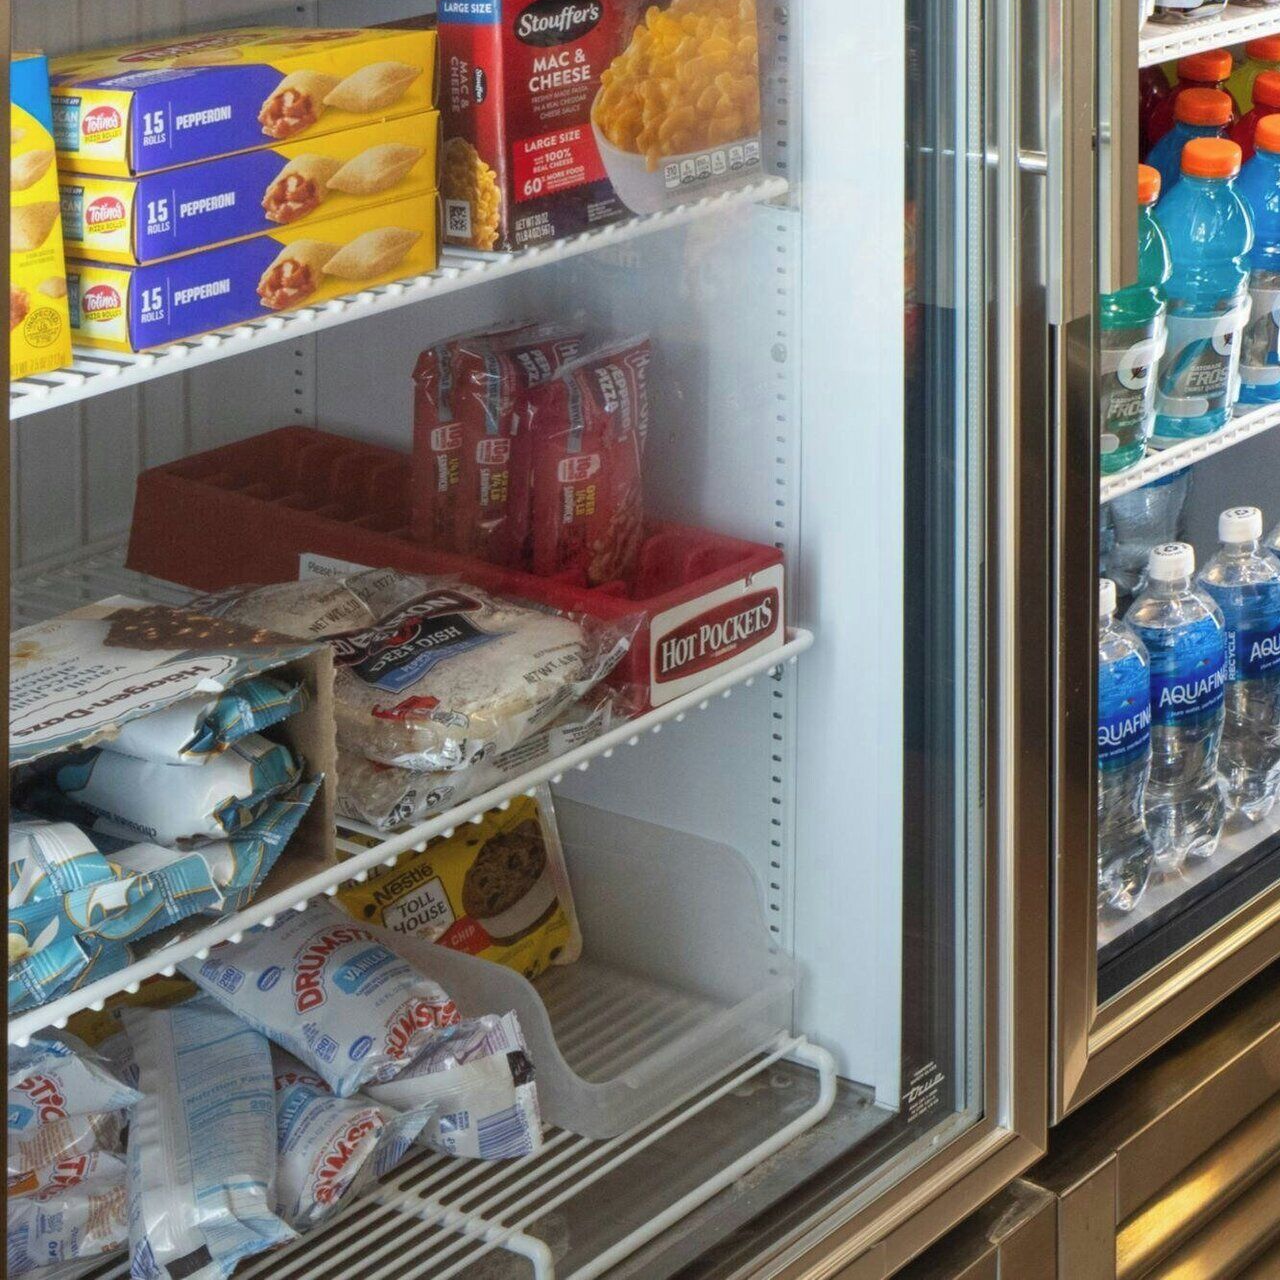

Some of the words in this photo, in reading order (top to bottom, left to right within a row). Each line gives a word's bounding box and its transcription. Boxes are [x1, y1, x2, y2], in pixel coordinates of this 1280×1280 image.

[443, 2, 469, 14] LARGE
[471, 2, 493, 14] SIZE
[519, 6, 600, 37] Stouffer's
[533, 53, 570, 73] MAC
[575, 49, 586, 64] &
[529, 65, 591, 92] CHEESE
[83, 113, 121, 133] Totino's
[143, 111, 164, 136] 15
[176, 106, 231, 130] PEPPERONI
[143, 133, 166, 146] ROLLS
[524, 136, 556, 153] LARGE
[559, 129, 581, 144] SIZE
[545, 148, 572, 162] 100%
[86, 203, 125, 223] Totino's
[147, 200, 167, 224] 15
[180, 192, 235, 217] PEPPERONI
[147, 221, 170, 235] ROLLS
[83, 291, 121, 311] Totino's
[141, 288, 162, 313] 15
[174, 280, 230, 305] PEPPERONI
[141, 310, 164, 324] ROLLS
[418, 626, 463, 649] DISH
[661, 636, 697, 673] HOT
[699, 599, 772, 650] POCKETS
[1228, 631, 1236, 681] RECYCLE
[12, 666, 211, 738] Häagen-Dazs
[374, 863, 433, 905] Nestlé
[399, 892, 434, 918] TOLL
[452, 925, 476, 945] CHIP
